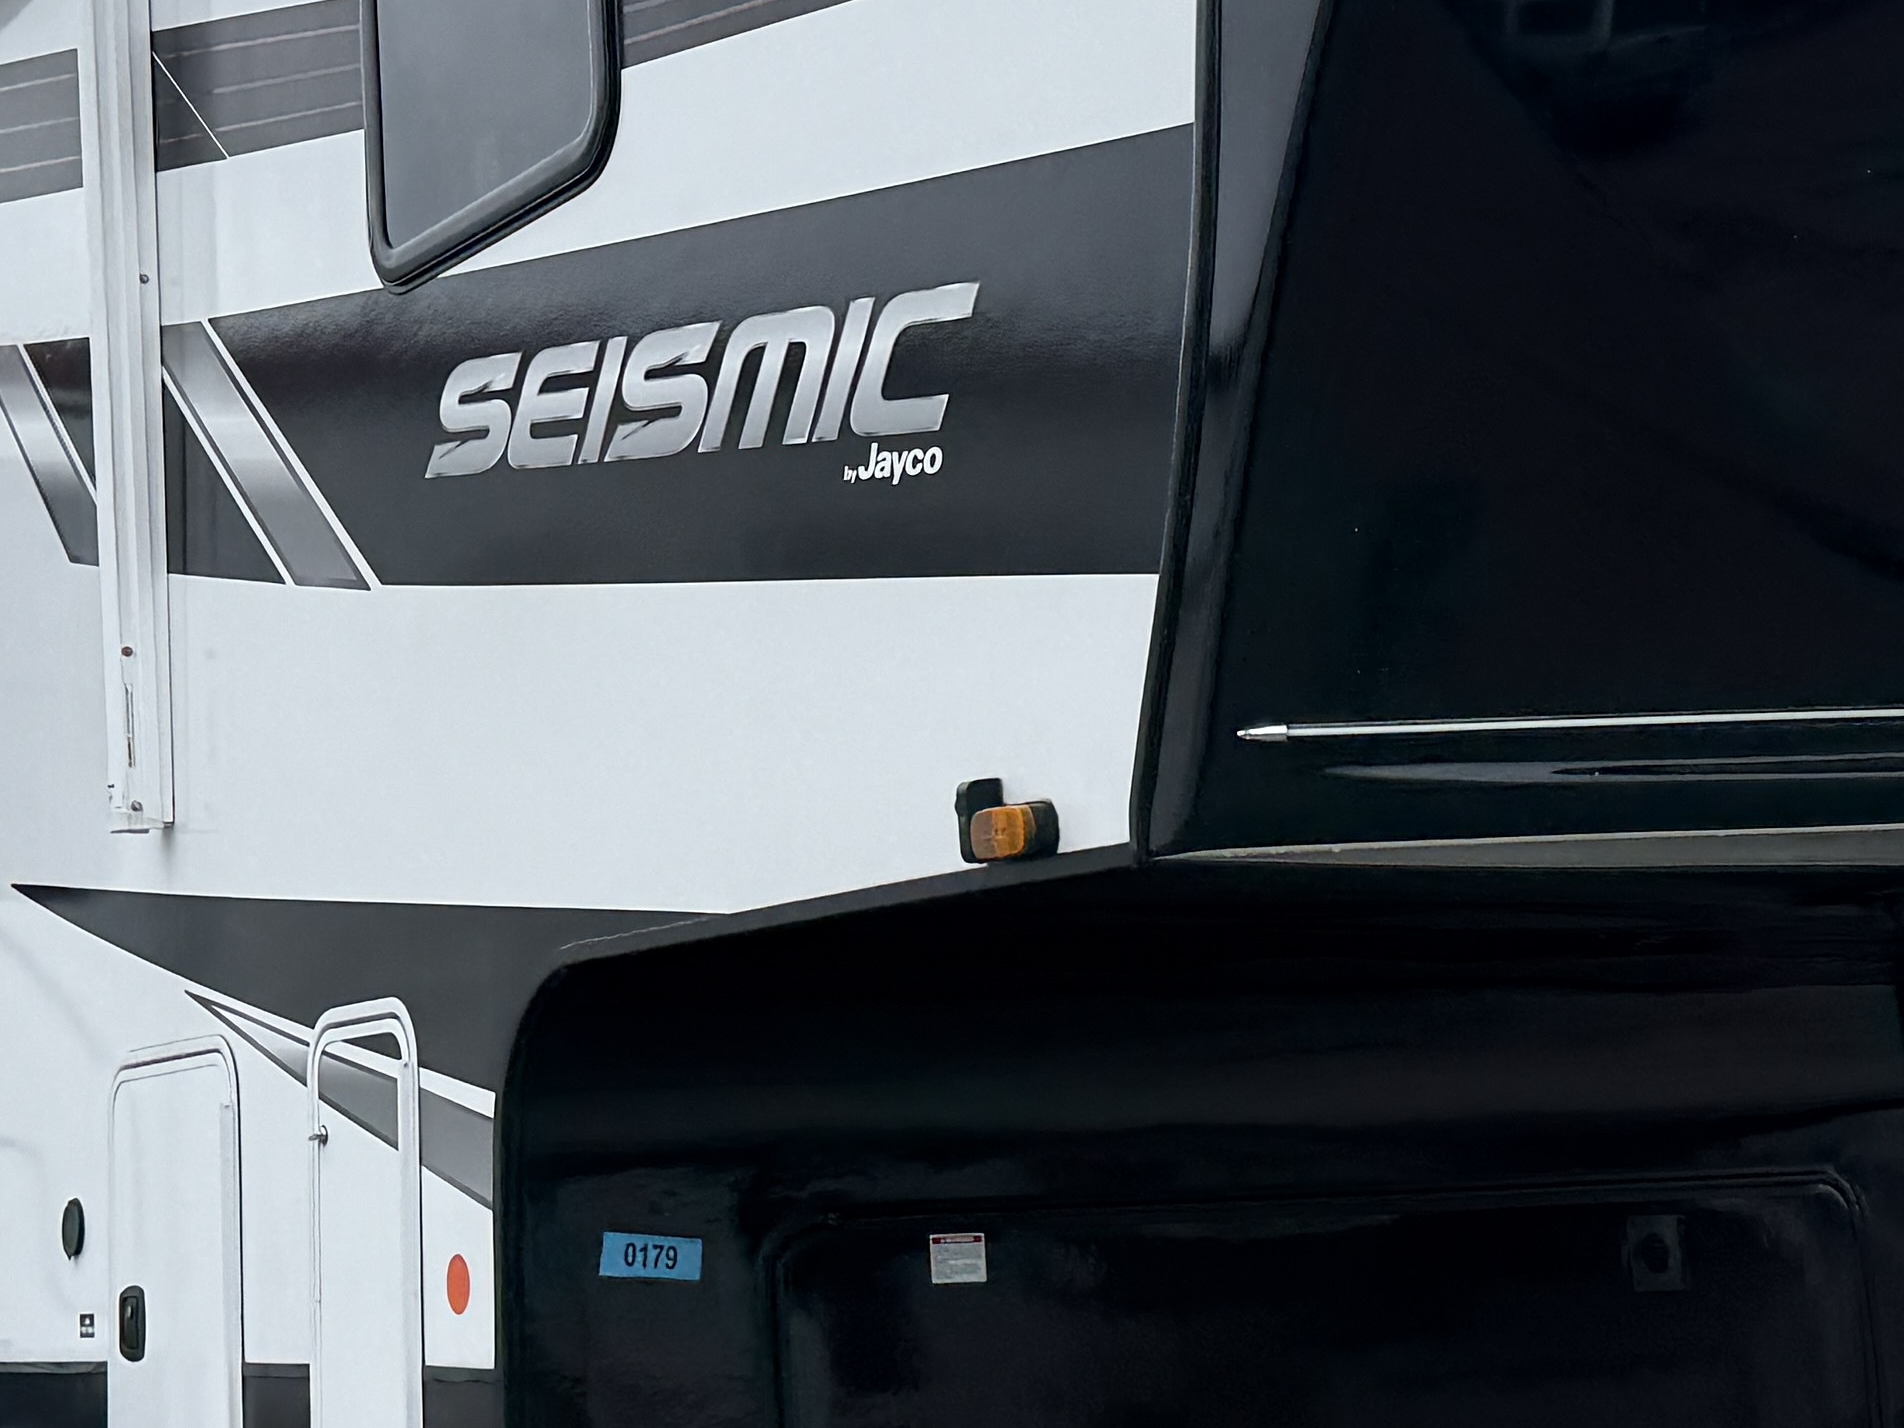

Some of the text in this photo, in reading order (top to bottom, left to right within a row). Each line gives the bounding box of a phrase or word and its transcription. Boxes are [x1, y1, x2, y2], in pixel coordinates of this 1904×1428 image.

[424, 282, 981, 479] SEISMIC
[843, 442, 944, 485] by Jayco
[624, 1242, 678, 1270] 0179
